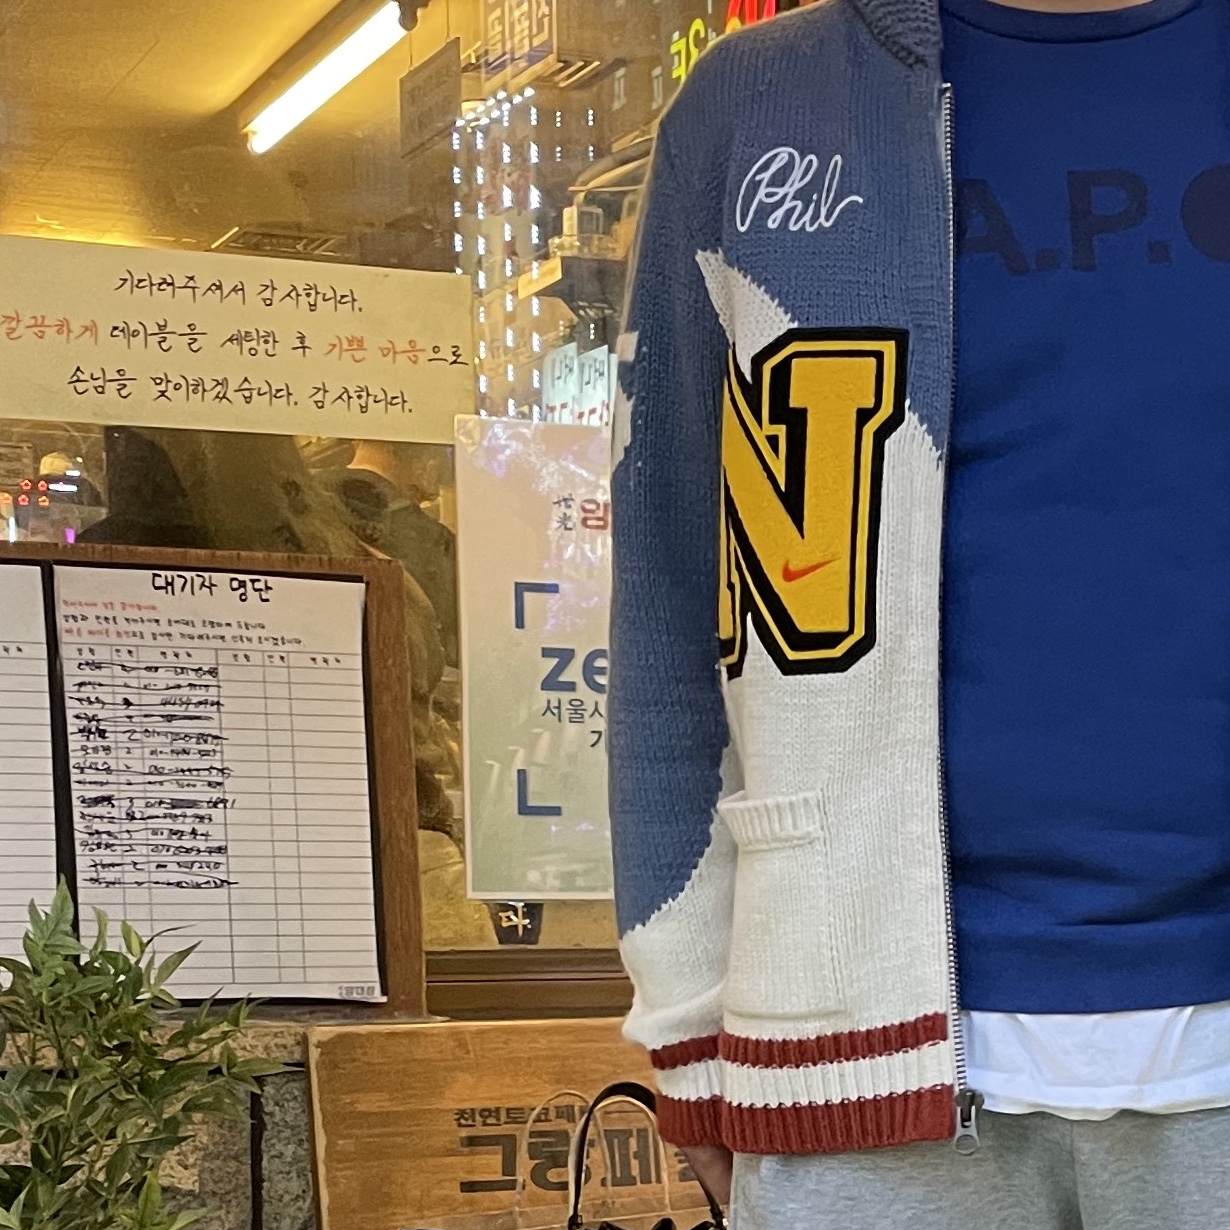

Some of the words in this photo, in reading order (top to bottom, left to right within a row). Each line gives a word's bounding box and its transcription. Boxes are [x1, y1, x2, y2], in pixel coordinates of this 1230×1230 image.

[736, 146, 863, 233] Phil
[113, 268, 246, 306] 기다려주셔서
[256, 278, 363, 312] 감사합니다.
[0, 310, 99, 346] 깔끔하게
[110, 318, 208, 353] 테이블을
[220, 328, 279, 356] 세팅한
[291, 331, 312, 357] 후
[324, 334, 368, 363] 기쁜
[378, 339, 469, 366] 마음으로
[67, 366, 138, 399] 손님을
[149, 372, 298, 407] 맞이하겠습니다.
[308, 381, 413, 414] 감사합니다.
[151, 572, 218, 596] 대기자
[229, 576, 274, 602] 명단
[459, 1126, 701, 1194] 그랑페
